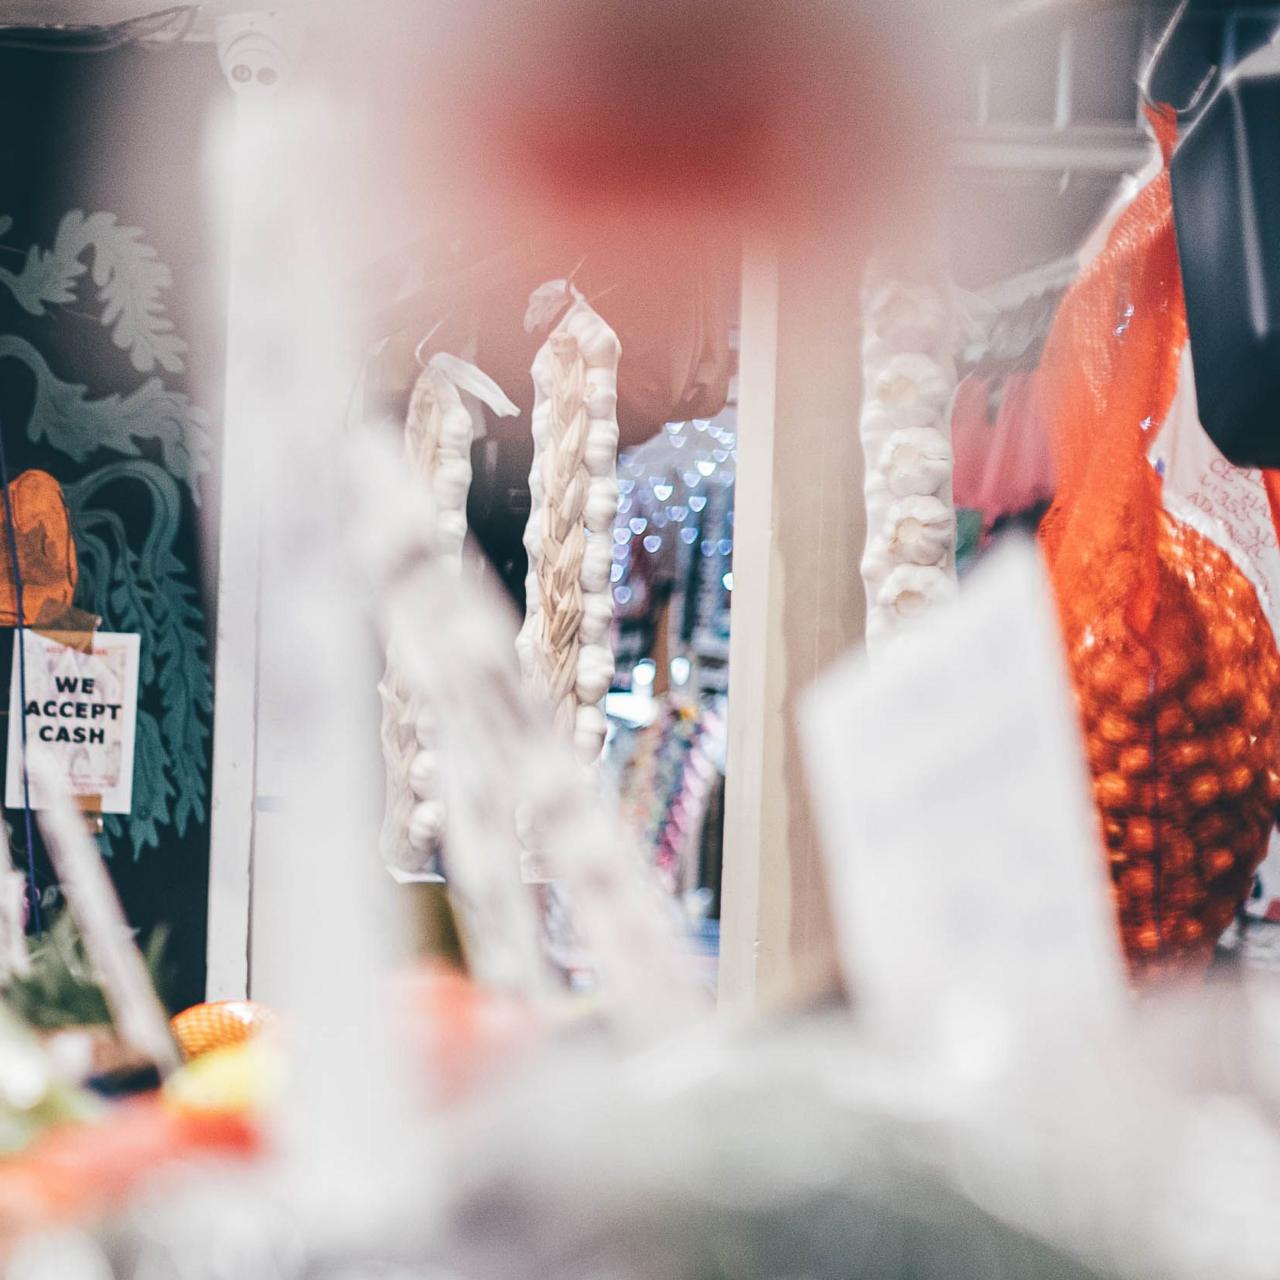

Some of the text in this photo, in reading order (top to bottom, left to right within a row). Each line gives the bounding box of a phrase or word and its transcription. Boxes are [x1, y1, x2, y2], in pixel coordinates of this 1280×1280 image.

[55, 676, 95, 694] WE
[25, 700, 122, 720] ACCEPT
[39, 725, 104, 744] CASH
